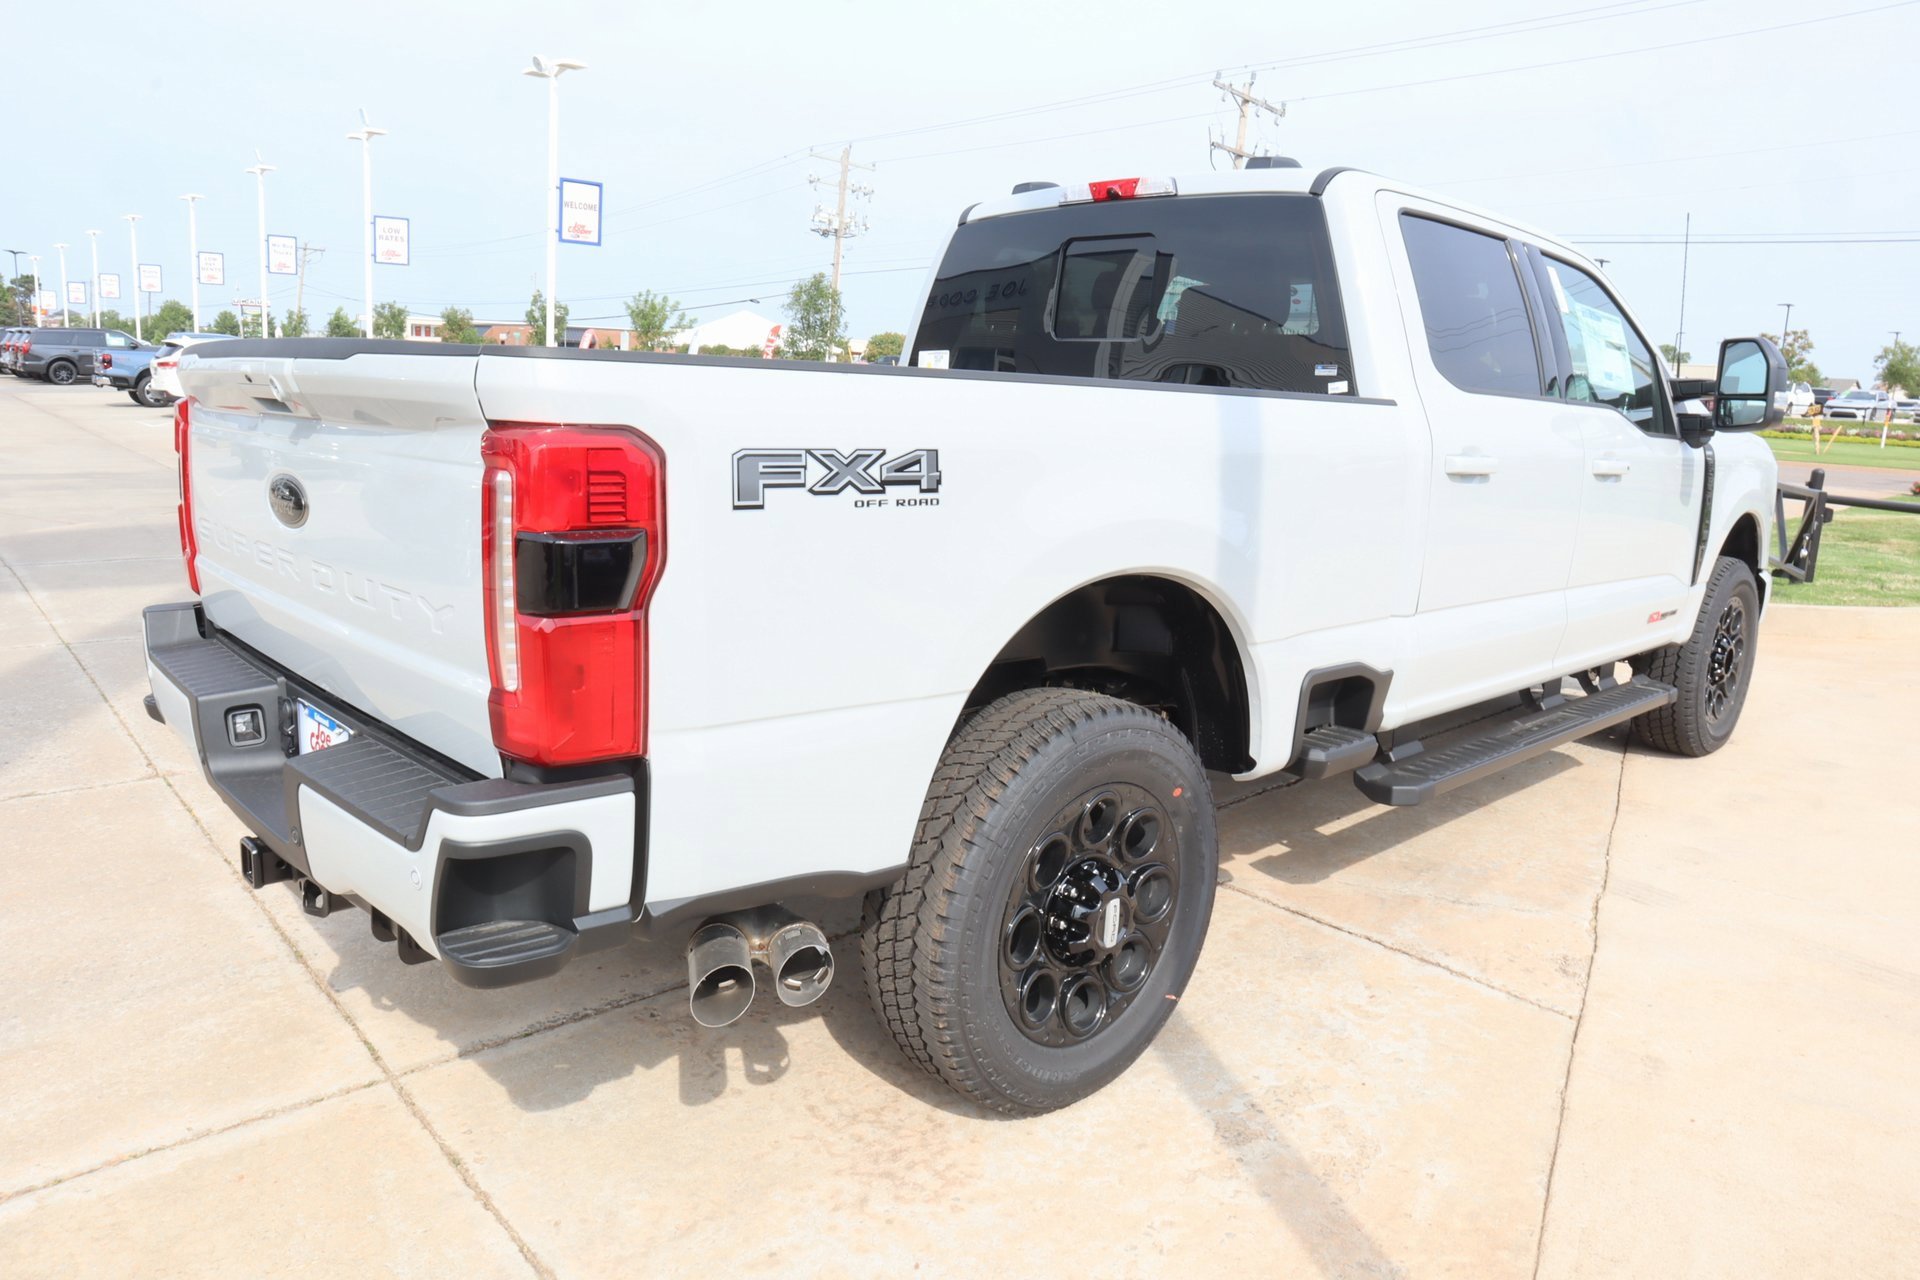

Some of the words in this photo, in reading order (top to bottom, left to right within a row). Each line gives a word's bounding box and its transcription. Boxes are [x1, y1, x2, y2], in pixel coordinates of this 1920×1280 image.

[564, 201, 598, 212] WELCOME
[378, 234, 405, 242] RATES
[732, 448, 942, 511] FX4
[854, 500, 889, 508] OFF
[896, 498, 940, 508] ROAD
[198, 516, 301, 583] SUPER
[311, 559, 455, 636] DUTY
